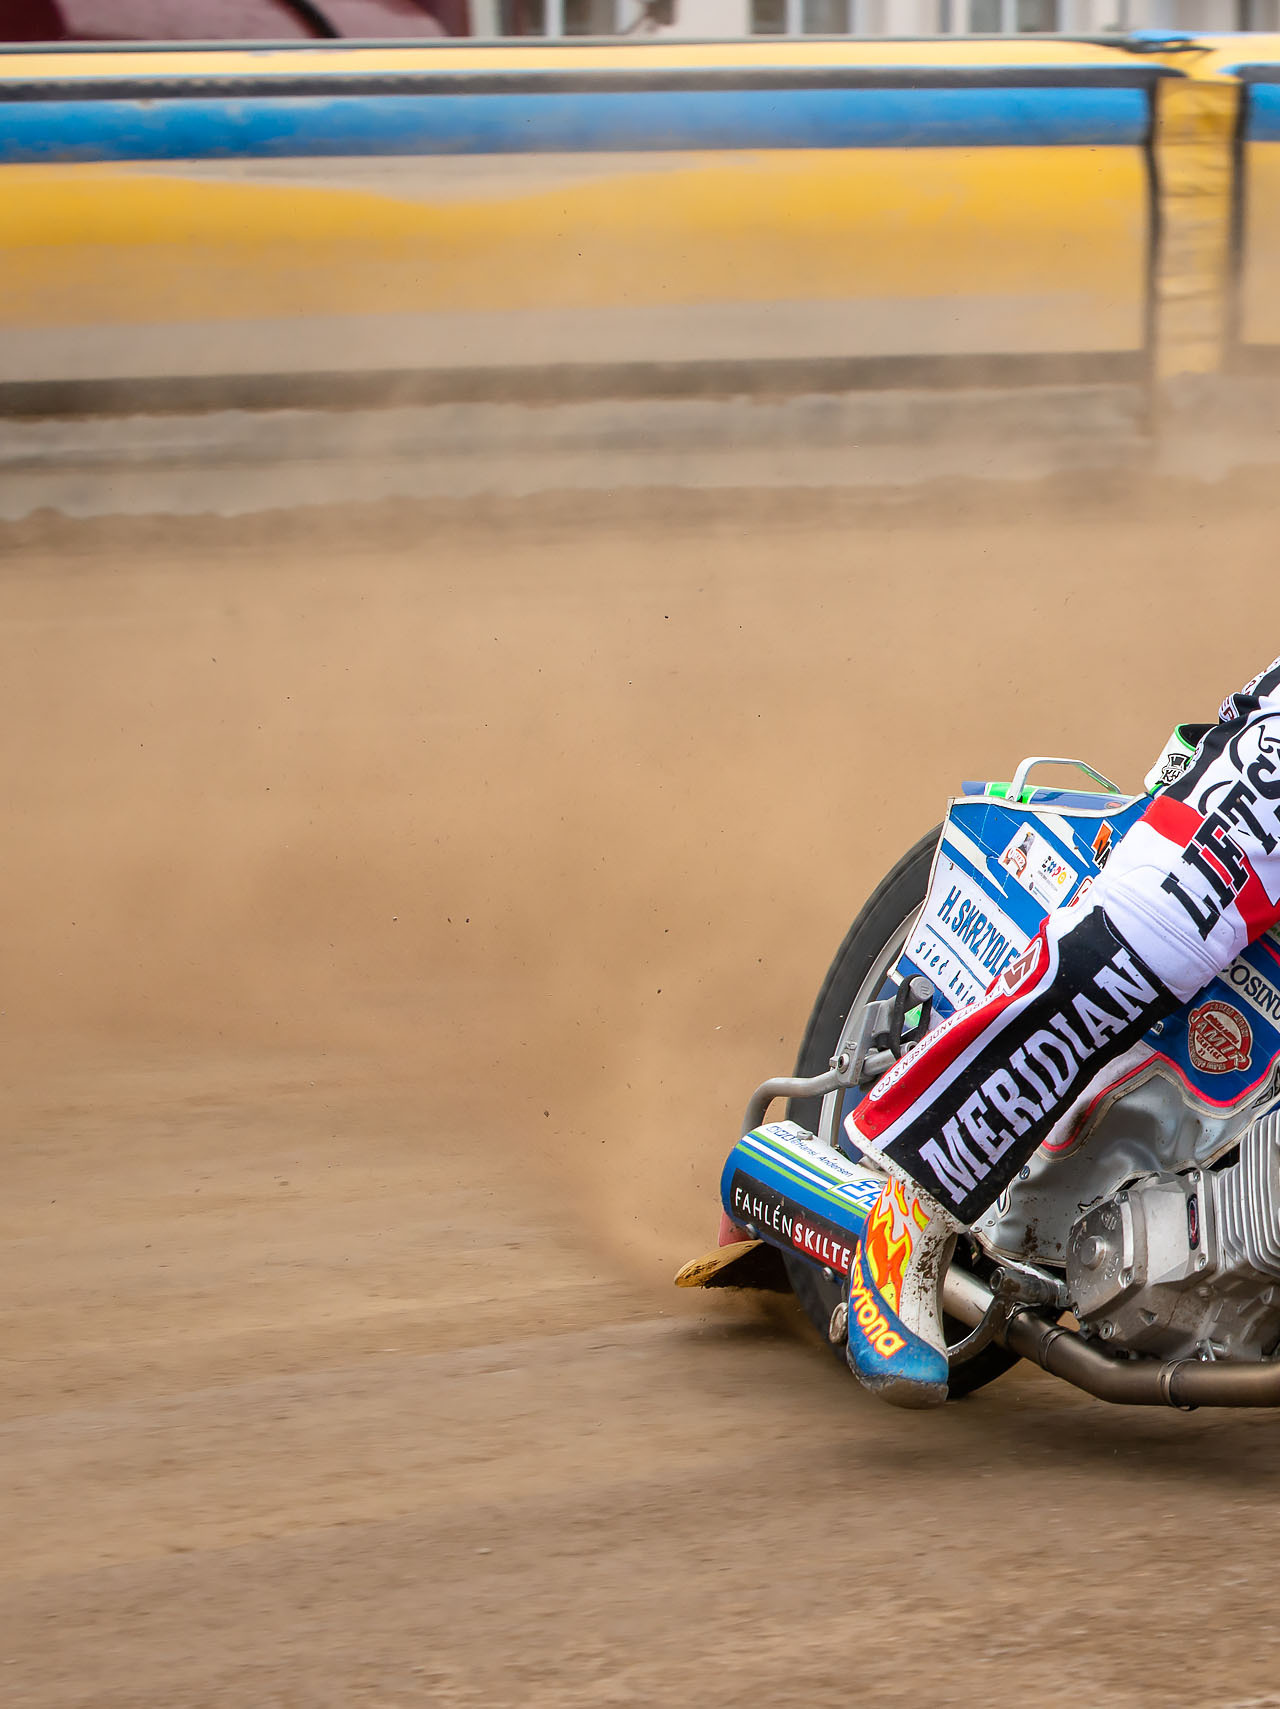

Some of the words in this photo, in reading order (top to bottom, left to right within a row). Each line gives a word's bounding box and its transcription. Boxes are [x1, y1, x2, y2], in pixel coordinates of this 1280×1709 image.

[937, 885, 1021, 977] H.SKRZYDLE
[918, 948, 1159, 1205] MERIDIAN
[735, 1187, 851, 1270] FAHLÉNSKILTE
